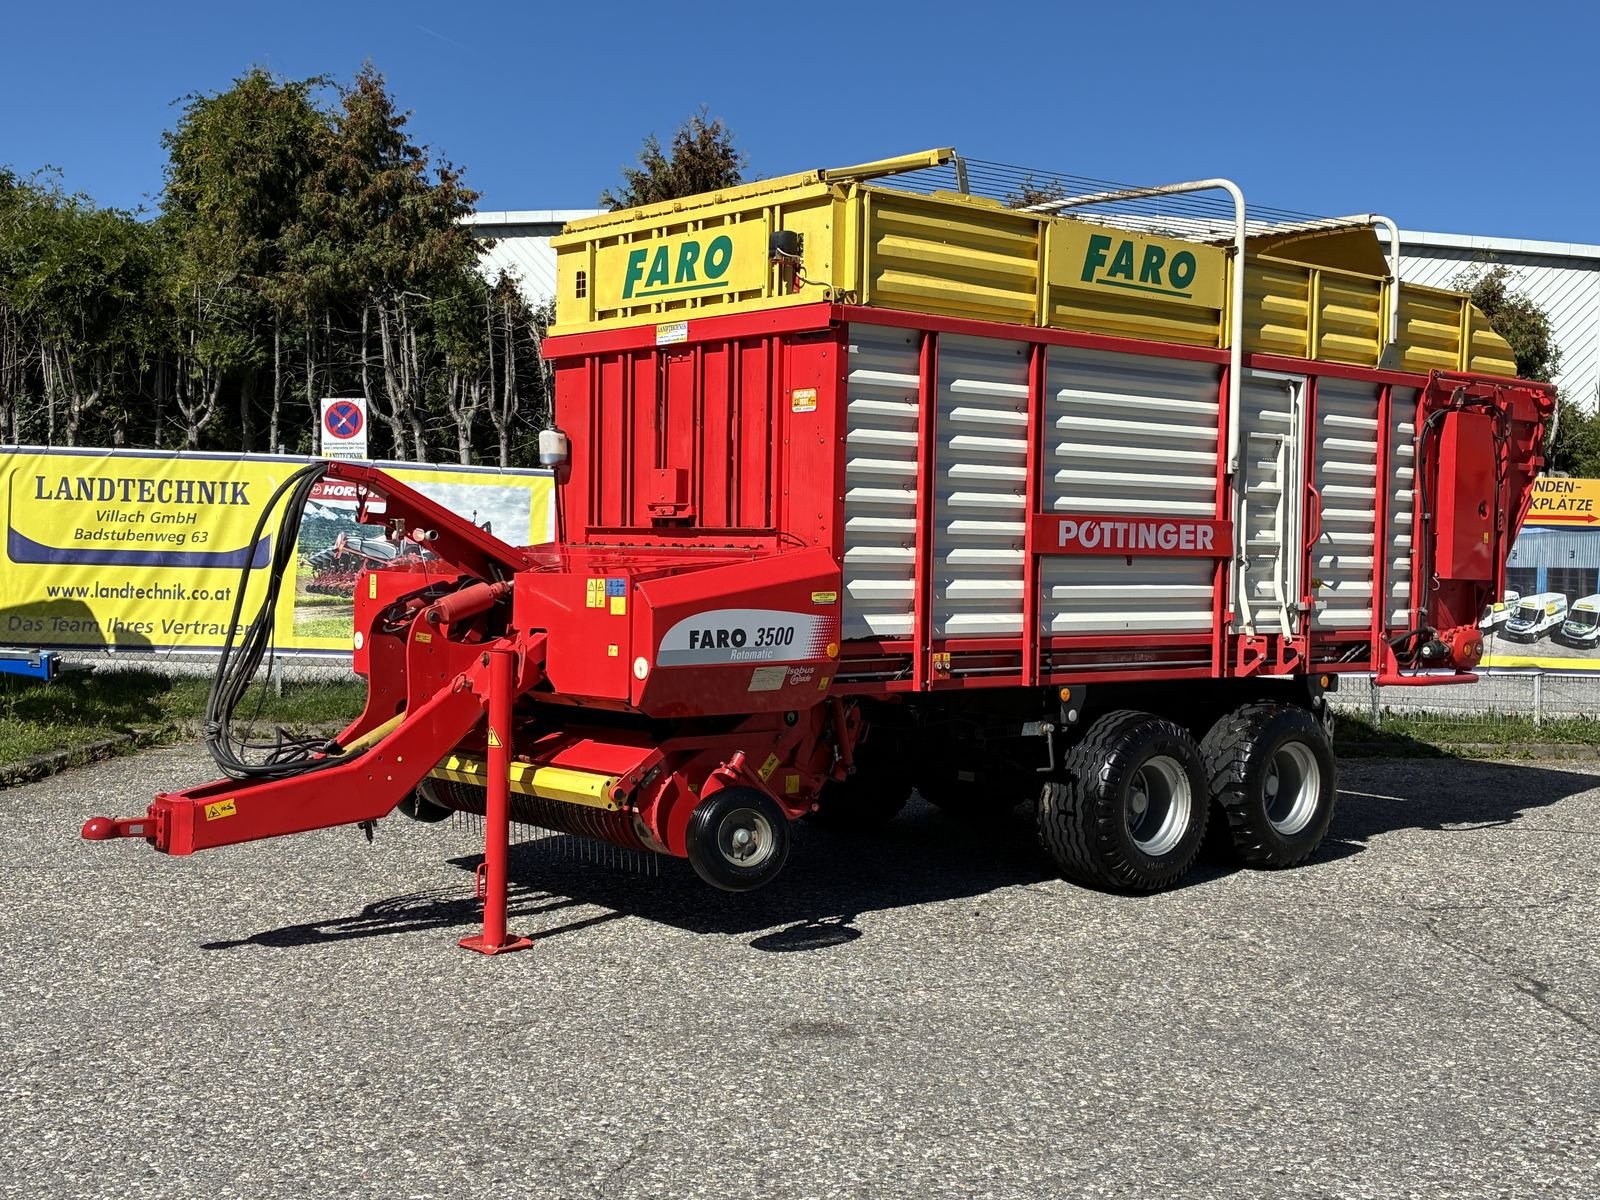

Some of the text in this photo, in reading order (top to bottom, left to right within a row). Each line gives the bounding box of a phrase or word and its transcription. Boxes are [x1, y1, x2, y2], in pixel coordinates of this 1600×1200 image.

[622, 234, 733, 300] FARO
[1080, 233, 1197, 290] FARO
[34, 475, 251, 506] LANDTECHNIK
[1533, 480, 1582, 493] NDEN-
[96, 510, 198, 525] Villach GmbH
[73, 527, 209, 546] Badstubenweg 63
[1058, 519, 1215, 550] PÖTTINGER
[1569, 550, 1576, 560] 3
[46, 581, 232, 601] www.landtechnik.co.at
[7, 616, 43, 632] Das
[51, 616, 100, 633] Team
[106, 616, 154, 635] Ihres
[689, 626, 794, 649] FARO 3500
[730, 649, 773, 660] Rotomatic
